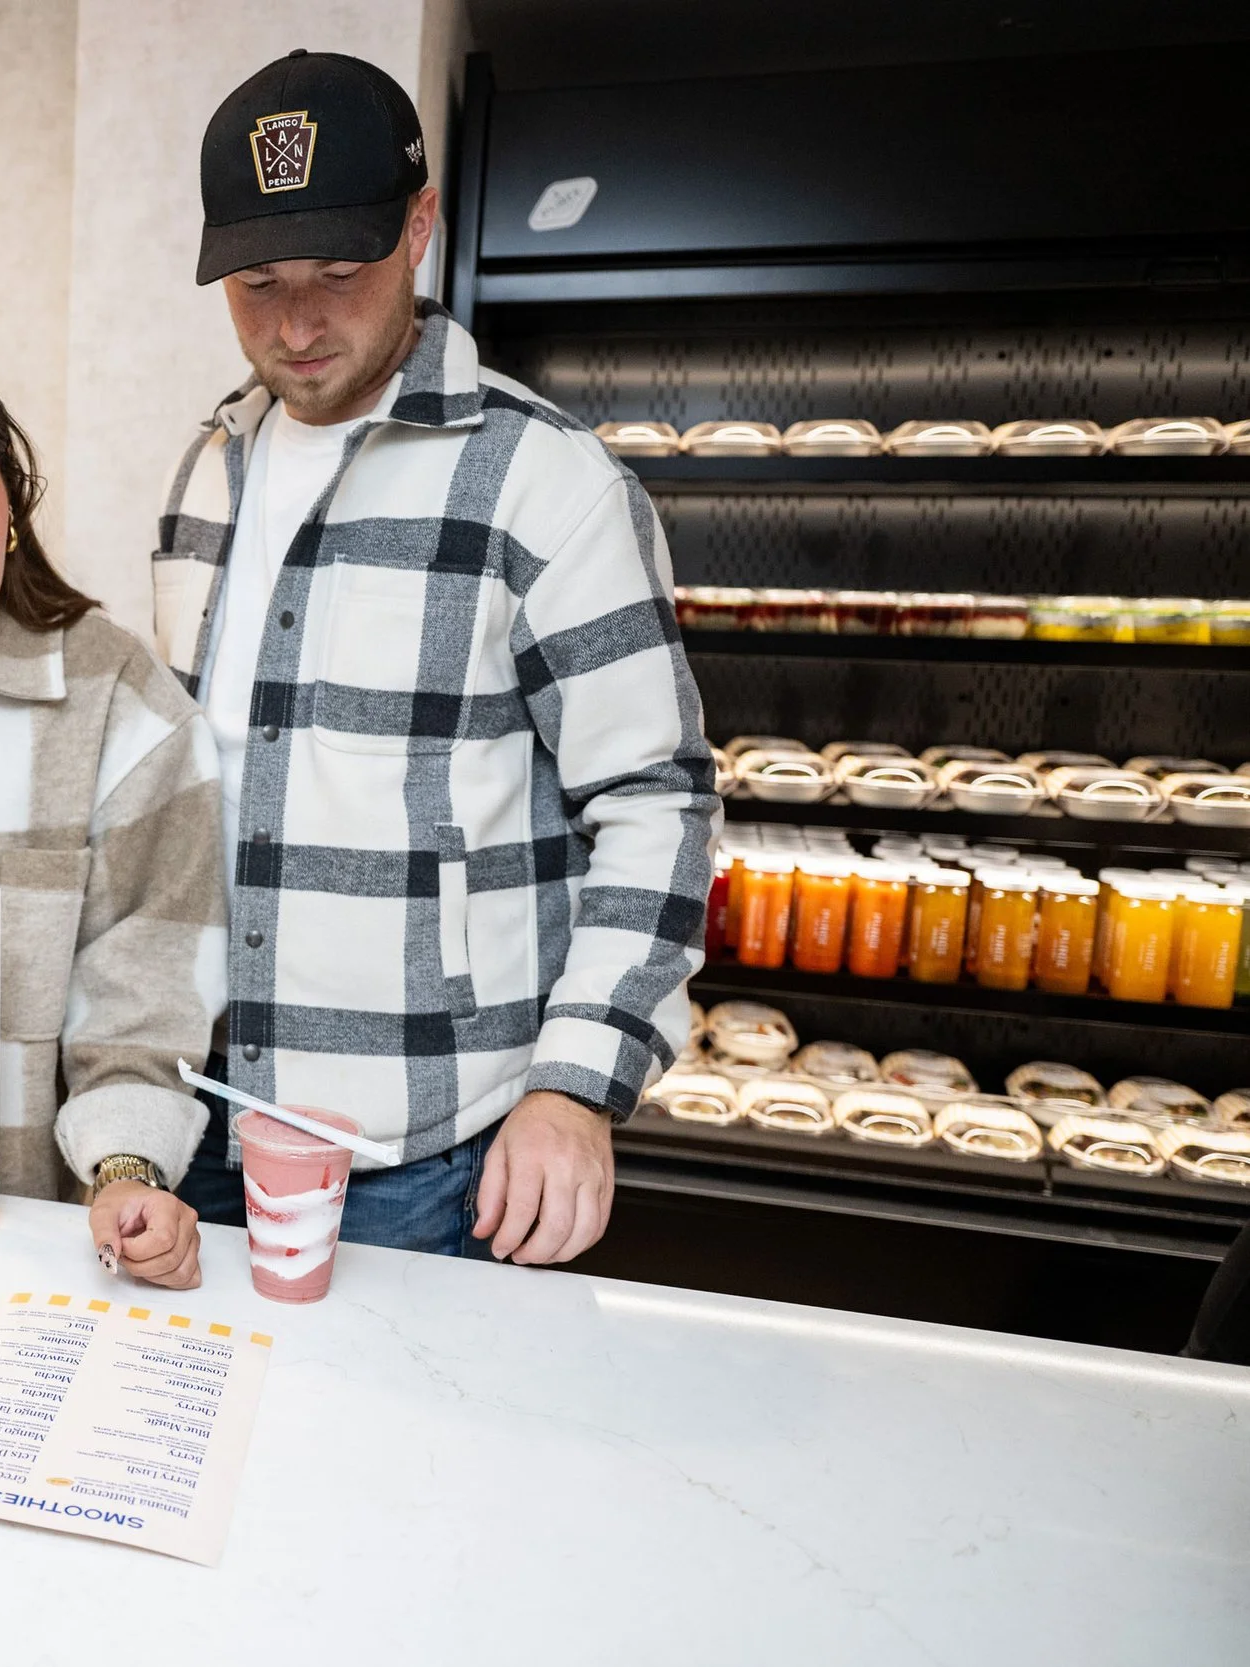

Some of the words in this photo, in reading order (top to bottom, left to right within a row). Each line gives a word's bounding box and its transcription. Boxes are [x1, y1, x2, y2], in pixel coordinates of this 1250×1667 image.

[266, 118, 298, 130] LANCO
[278, 130, 287, 146] A
[265, 147, 272, 162] L
[294, 144, 303, 158] N
[279, 161, 288, 176] C
[268, 176, 301, 187] PENNA
[64, 1321, 72, 1330] C
[74, 1322, 95, 1332] Vita
[37, 1335, 89, 1349] Sunshine
[181, 1343, 215, 1356] Green
[217, 1350, 232, 1360] Go
[15, 1350, 81, 1366] Strawberry
[141, 1353, 183, 1369] Dragon
[34, 1371, 73, 1384] Mocha
[185, 1363, 228, 1378] Cosmic
[21, 1388, 64, 1402] Matcha
[164, 1379, 222, 1397] Chocolate
[14, 1406, 56, 1422] Mango
[175, 1401, 217, 1417] Cherry
[144, 1418, 181, 1432] Magic
[5, 1426, 46, 1442] Mango
[183, 1426, 211, 1439] Blue
[10, 1451, 37, 1463] Lets
[168, 1449, 203, 1465] Berry
[126, 1465, 158, 1479] Lush
[160, 1473, 197, 1489] Berry
[71, 1485, 136, 1505] Buttercup
[140, 1499, 189, 1519] Banana
